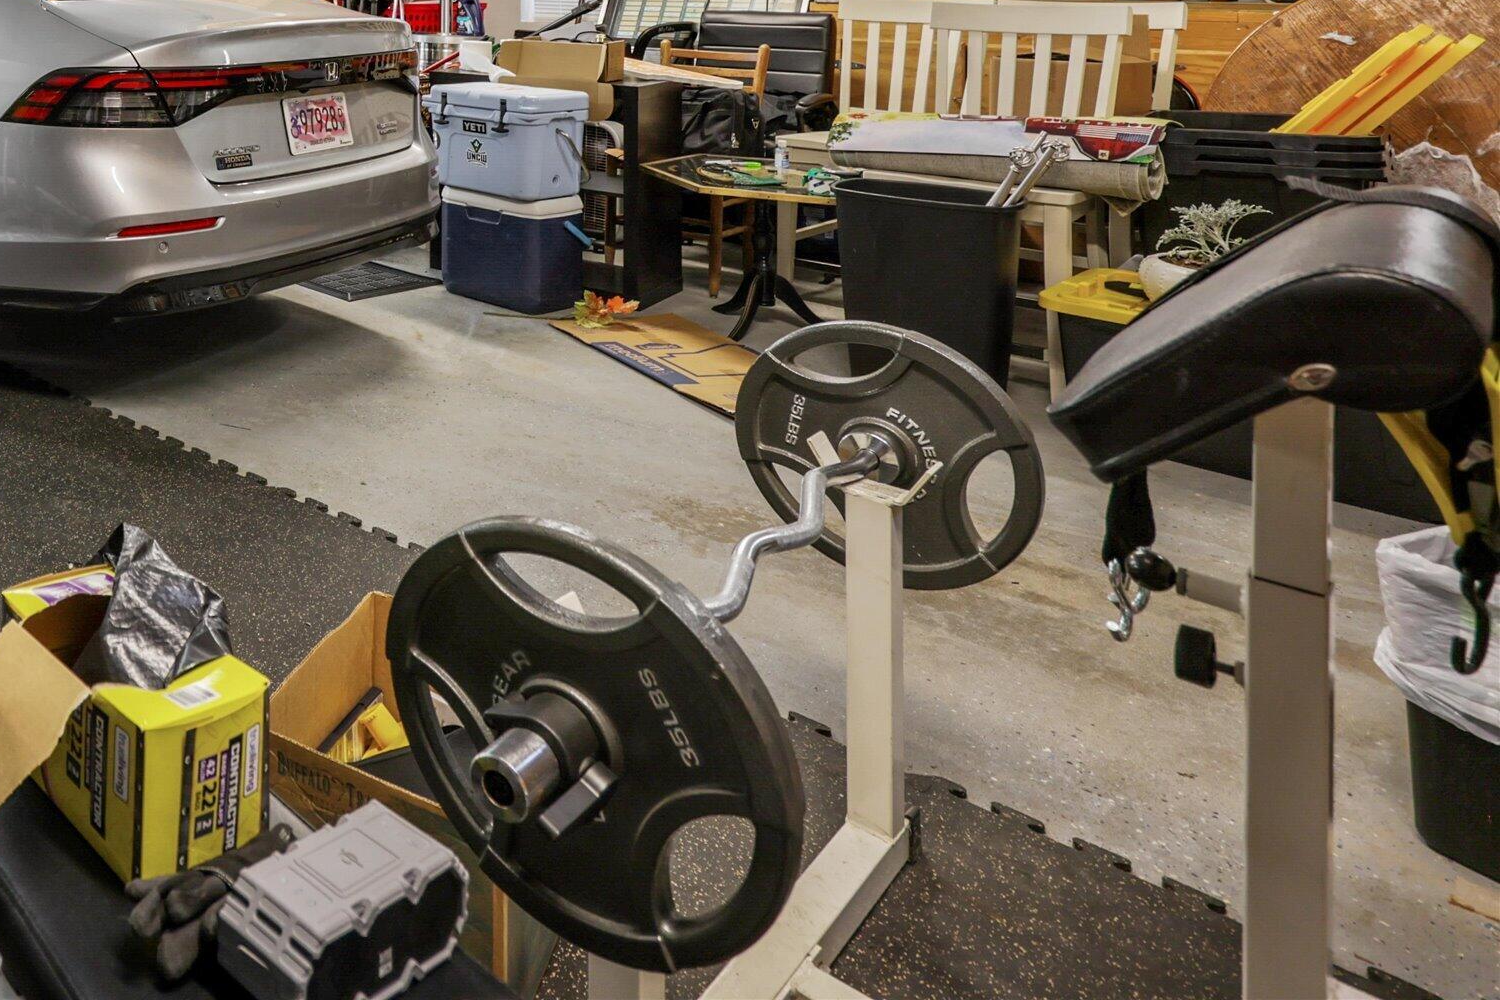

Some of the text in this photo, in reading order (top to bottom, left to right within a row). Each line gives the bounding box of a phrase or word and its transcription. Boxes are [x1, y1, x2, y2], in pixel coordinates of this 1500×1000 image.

[300, 106, 338, 135] 97928
[464, 121, 485, 132] YETI
[785, 394, 806, 446] 35LBS
[886, 407, 938, 470] FITNES
[492, 650, 532, 706] EAR
[638, 668, 700, 768] 35LBS
[93, 714, 105, 828] CONTRACTOR
[115, 732, 128, 795] trueliving
[205, 758, 216, 777] 42
[246, 728, 259, 793] trueliving
[278, 751, 331, 796] BUFFALO
[201, 781, 217, 812] 22
[224, 742, 241, 851] CONTRACTOR
